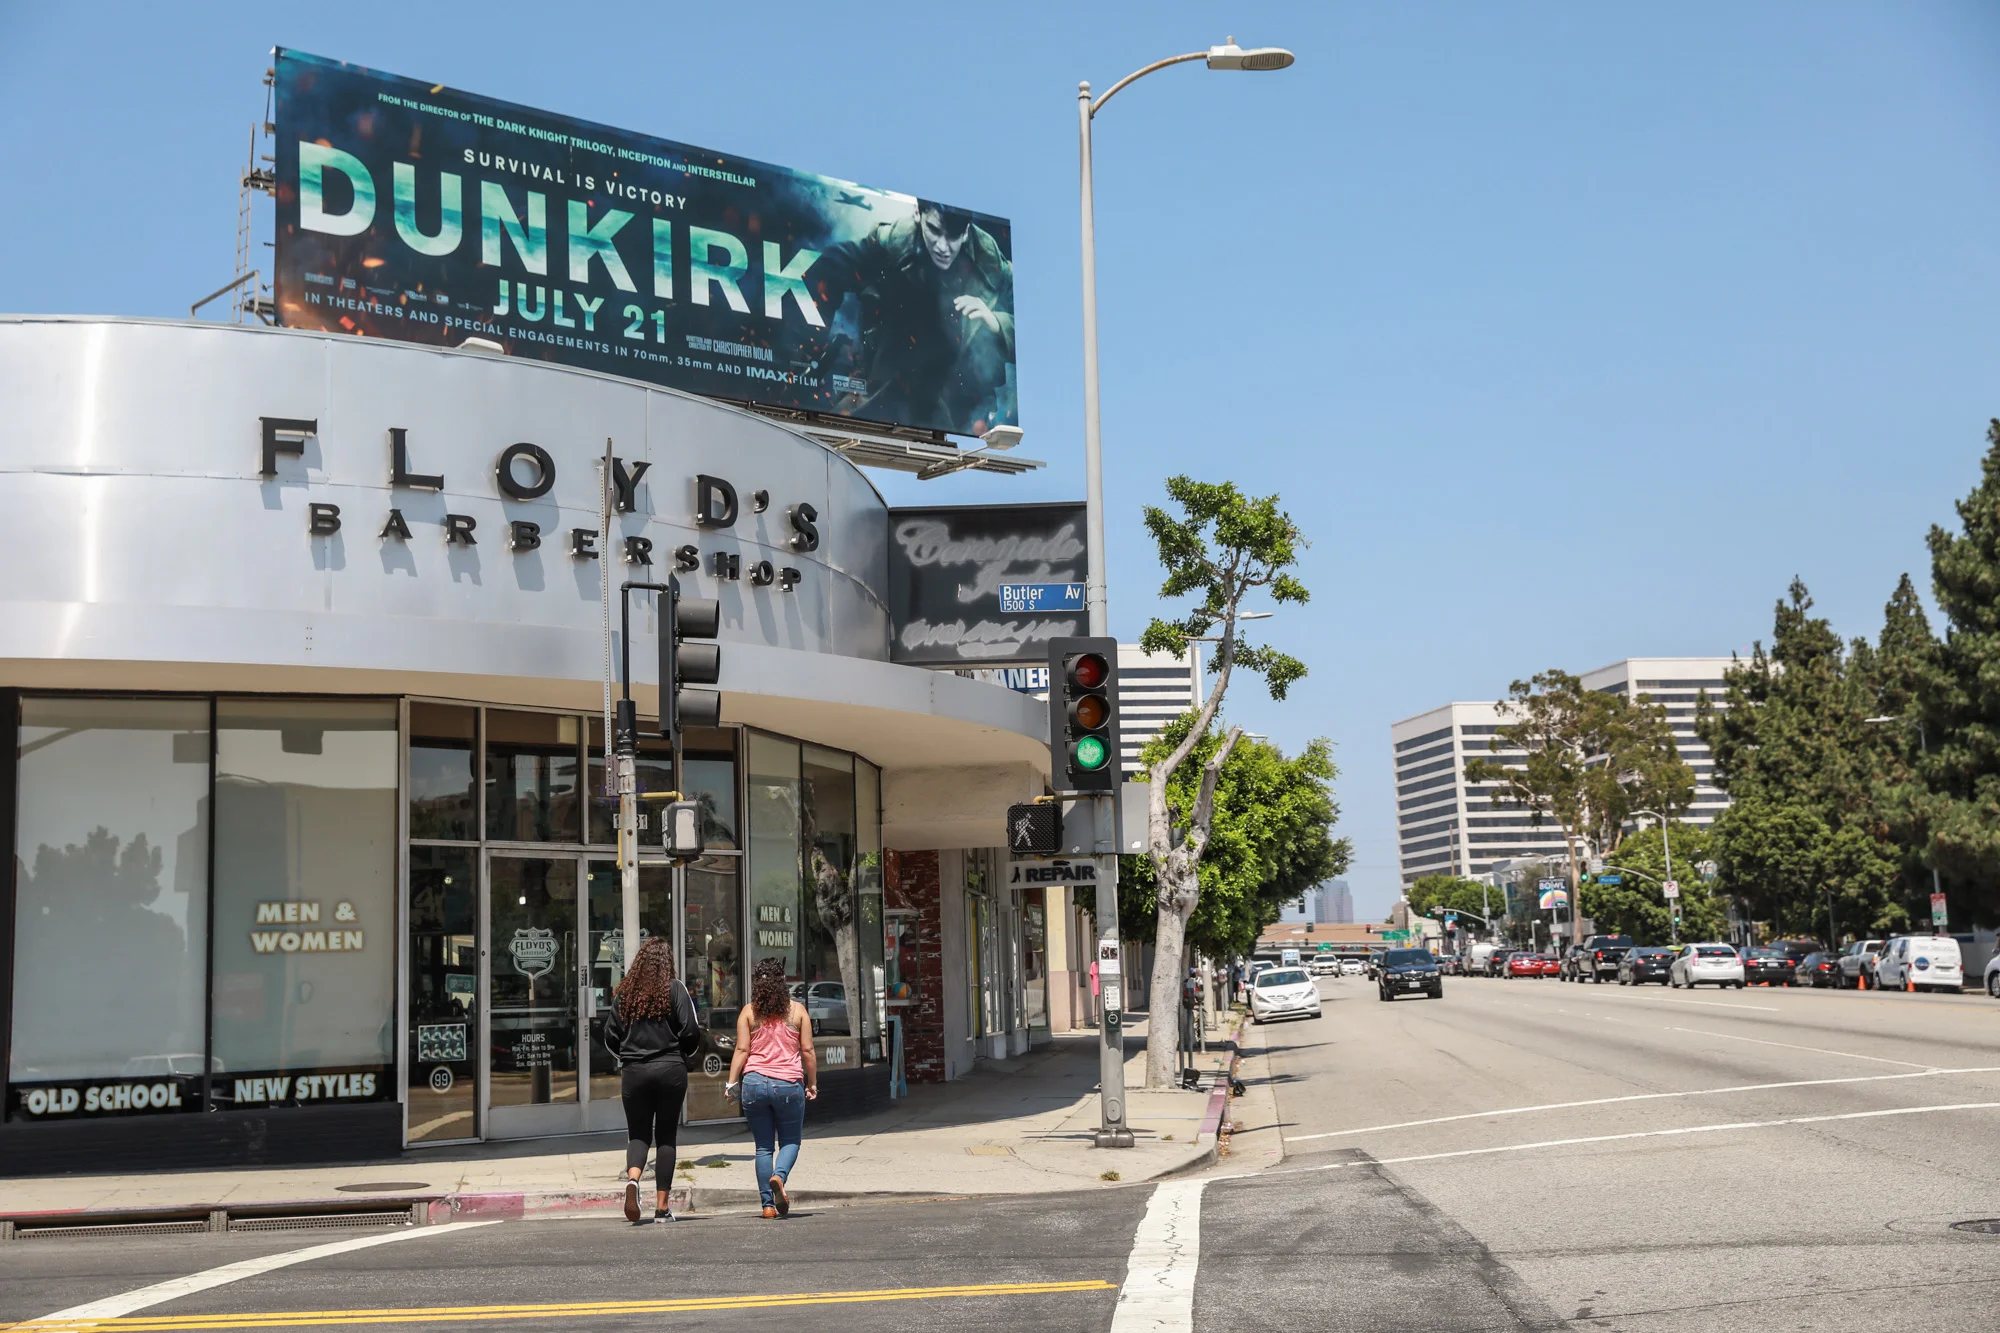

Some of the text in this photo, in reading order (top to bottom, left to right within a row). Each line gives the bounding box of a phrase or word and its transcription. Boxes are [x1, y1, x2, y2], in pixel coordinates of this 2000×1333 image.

[378, 93, 756, 187] FROM THE DIRECTOR OF THE DARK KNIGHT TRILOGY, INCEPTION AND INTERSTELLAR
[464, 148, 687, 210] SURVIVAL IS VICTORY
[299, 141, 826, 327] DUNKIRK
[493, 278, 666, 344] JULY 21
[305, 291, 320, 304] IN
[327, 295, 403, 318] THEATERS
[409, 310, 439, 324] AND
[445, 316, 503, 336] SPECIAL
[509, 327, 610, 354] ENGAGEMENTS
[615, 347, 628, 357] IN
[633, 349, 673, 365] 70mm,
[677, 356, 712, 371] 35mm
[717, 362, 741, 375] AND
[746, 366, 789, 383] IMAX
[792, 374, 818, 387] FILM
[713, 340, 773, 362] CHRISTOPHER NOLAN
[258, 416, 819, 552] FLOYD'S
[309, 502, 801, 593] BARBERSHOP
[1003, 585, 1081, 600] Butler Av
[1003, 600, 1035, 611] 1500 S
[1026, 865, 1096, 883] REPAIR
[1539, 881, 1566, 890] BOWL
[256, 901, 357, 924] MEN &
[760, 905, 791, 923] MEN &
[250, 930, 364, 953] WOMEN
[515, 941, 552, 953] FLOYD'S
[759, 930, 794, 947] WOMEN
[521, 1033, 546, 1043] HOURS
[706, 1058, 719, 1072] 99
[826, 1045, 846, 1065] COLOR
[234, 1072, 376, 1103] NEW STYLES
[434, 1073, 448, 1087] 99
[28, 1083, 182, 1115] OLD SCHOOL
